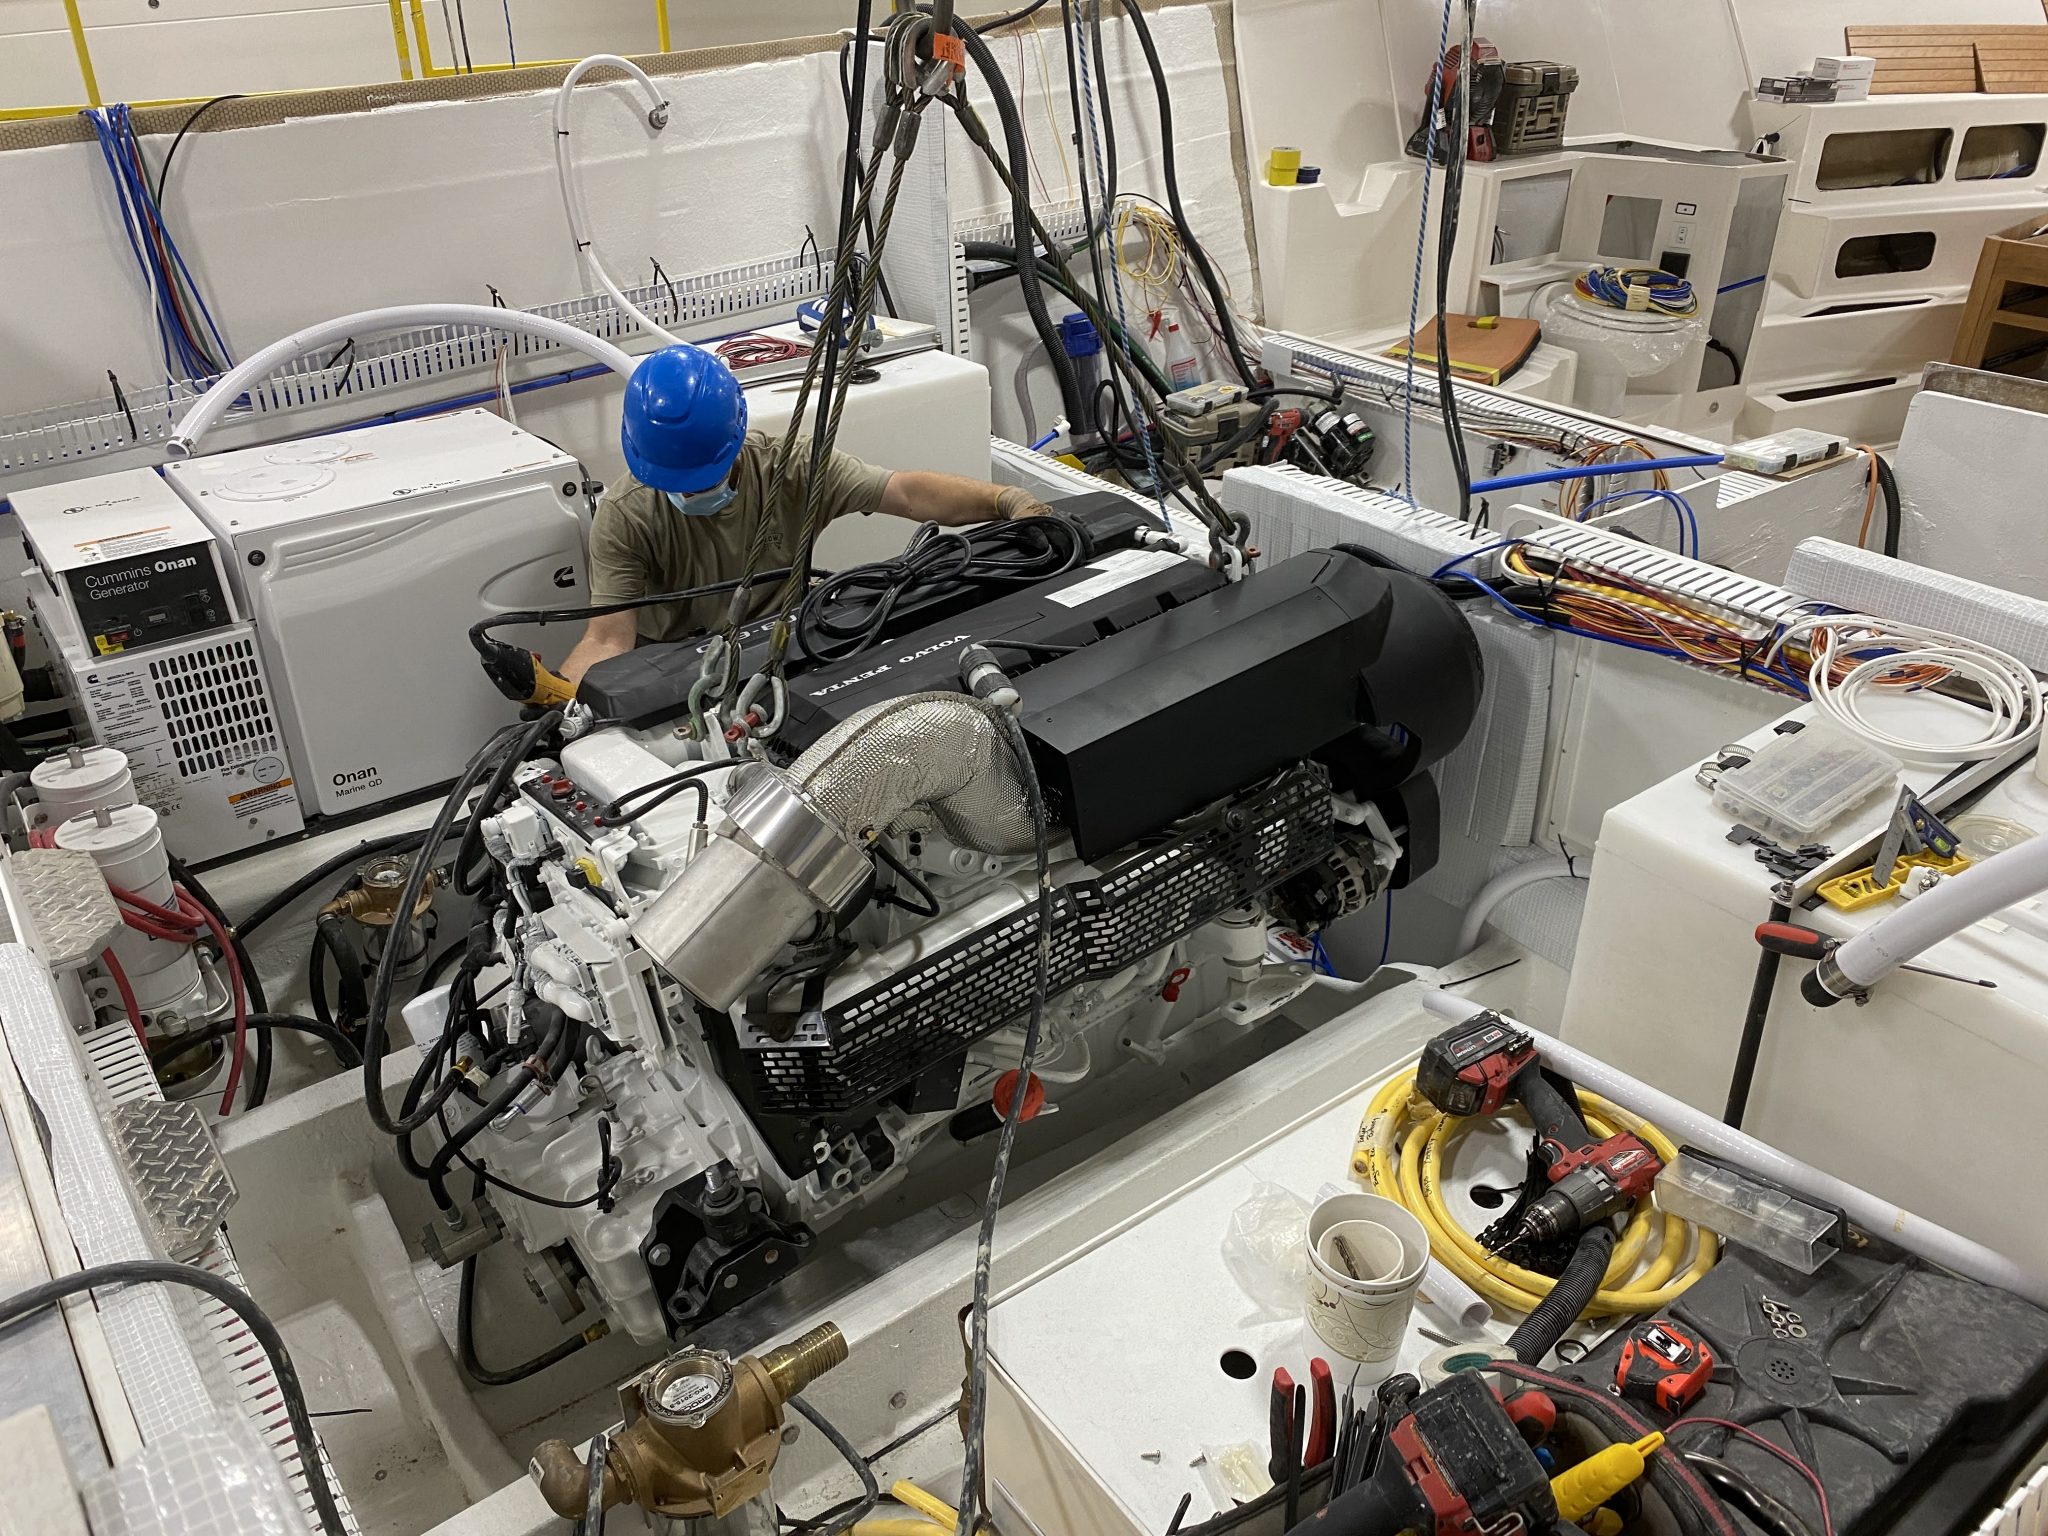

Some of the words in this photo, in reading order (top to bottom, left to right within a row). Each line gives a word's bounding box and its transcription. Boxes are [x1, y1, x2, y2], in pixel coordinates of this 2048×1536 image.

[85, 566, 151, 588] Cummins
[154, 556, 197, 573] Onan
[90, 579, 150, 600] Generator
[899, 634, 972, 663] VOLVO
[809, 664, 893, 696] PENTA
[333, 767, 377, 786] Onan
[247, 783, 281, 798] WARNING
[335, 785, 366, 798] Marine
[368, 778, 383, 788] QD
